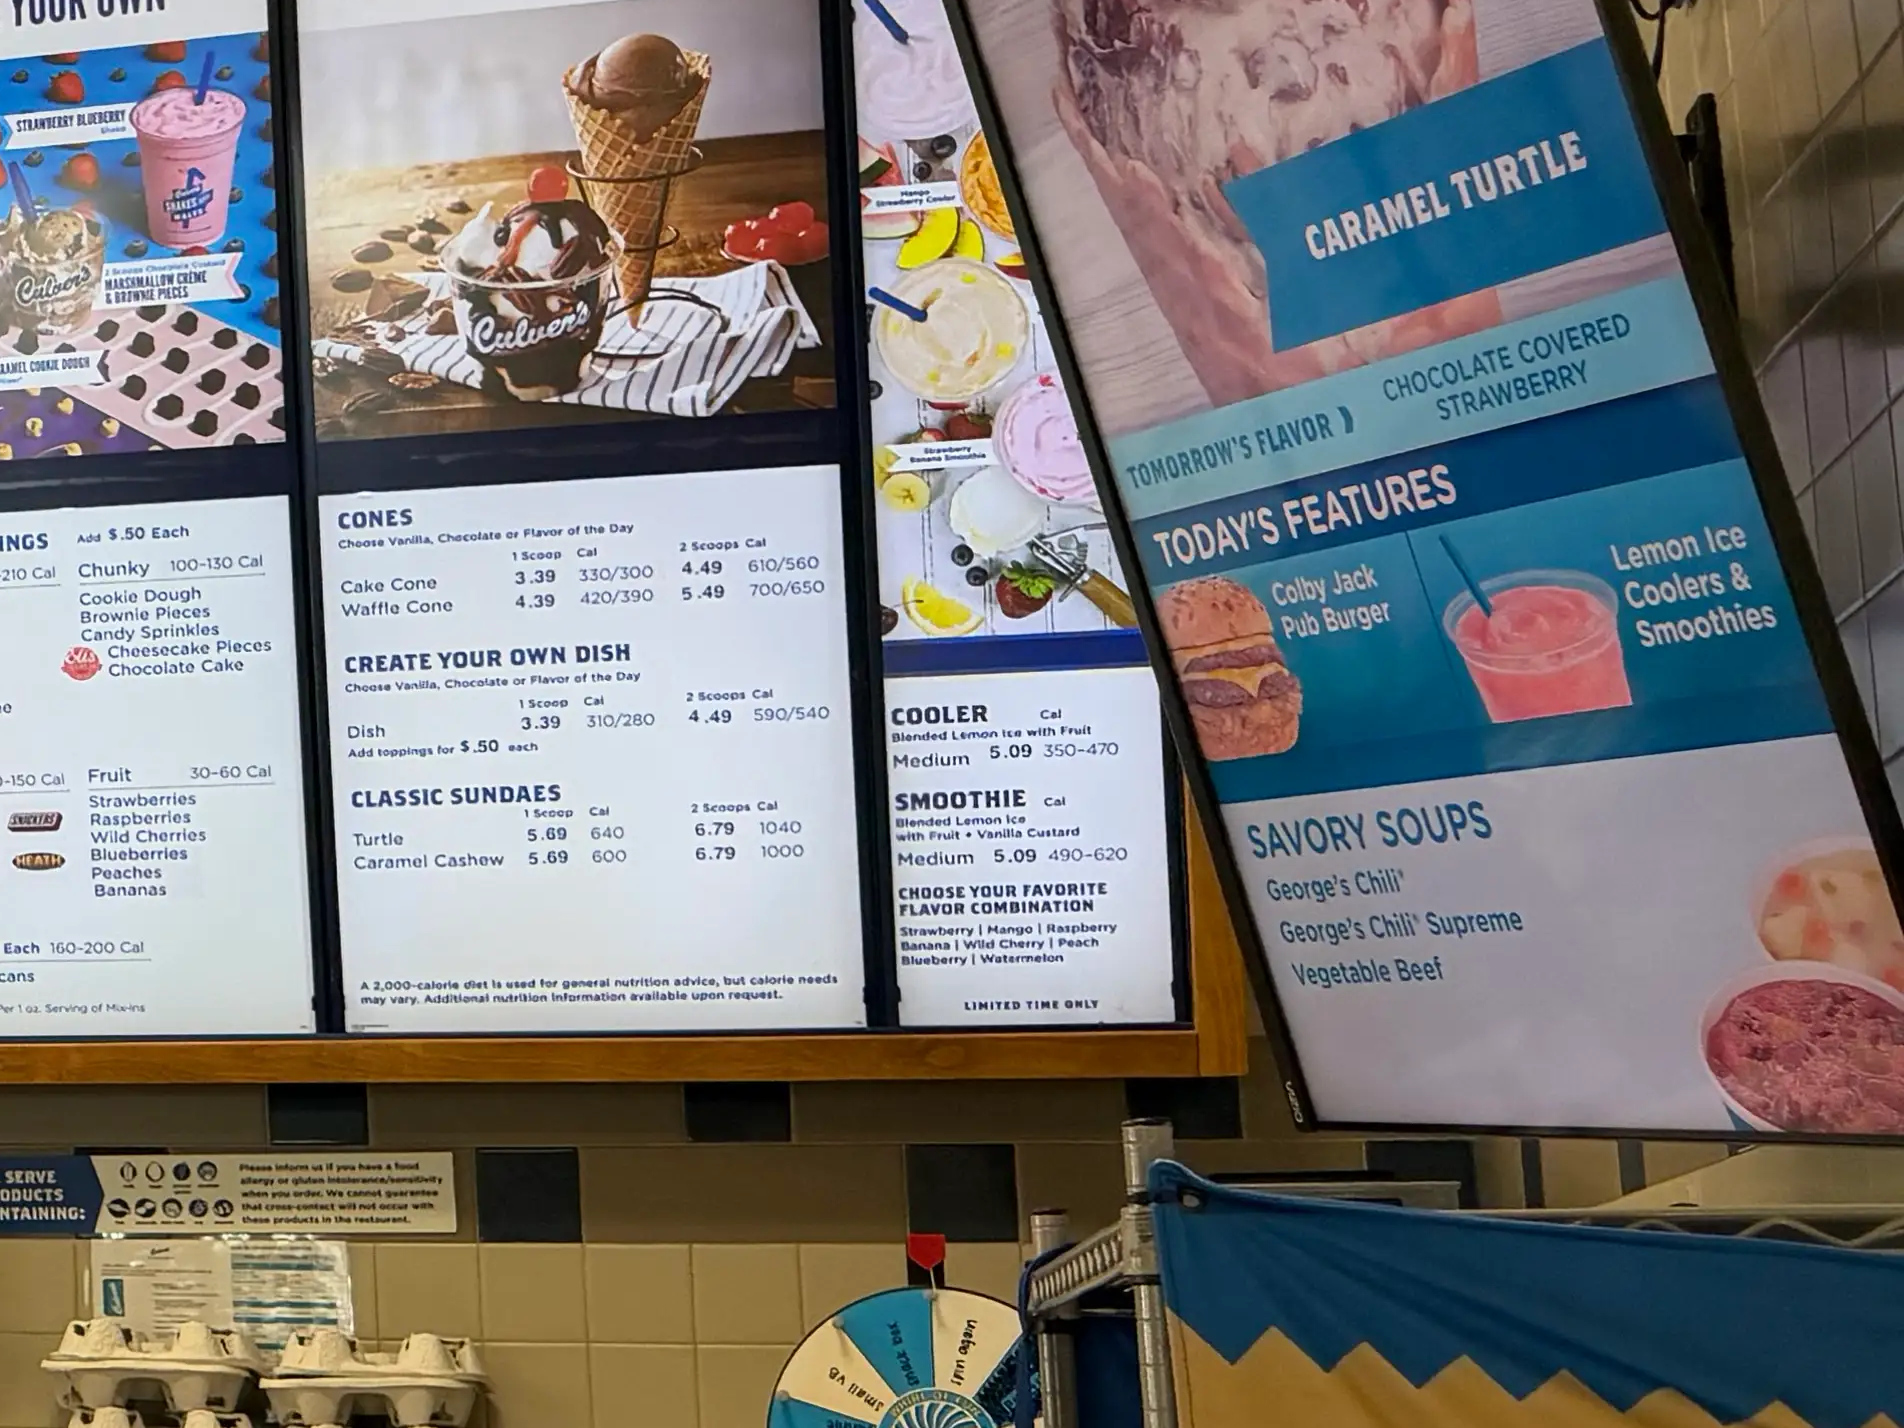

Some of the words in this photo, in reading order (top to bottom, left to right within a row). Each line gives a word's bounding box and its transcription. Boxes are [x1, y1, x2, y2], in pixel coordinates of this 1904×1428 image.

[1305, 182, 1449, 259] CARAMEL
[1450, 132, 1587, 208] TURTLE
[1382, 342, 1514, 403] CHOCOLATE
[1517, 314, 1631, 365] COVERED
[1436, 358, 1590, 422] STRAWBERRY
[1126, 435, 1252, 488] TOMORROW'S
[1255, 414, 1333, 455] FLAVOR
[338, 509, 412, 529] CONES
[1153, 507, 1279, 567] TODAY'S
[1283, 464, 1457, 538] FEATURES
[1610, 536, 1700, 570] Lemon
[1704, 526, 1746, 552] Ice
[1272, 577, 1325, 605] Colby
[1333, 564, 1377, 594] Jack
[1625, 573, 1725, 608] Coolers
[1730, 562, 1751, 590] &
[341, 602, 397, 616] Waffle
[407, 600, 453, 613] Cone
[1281, 612, 1319, 639] Pub
[1322, 603, 1389, 631] Burger
[1636, 603, 1777, 647] Smoothies
[891, 705, 987, 725] COOLER
[89, 792, 196, 808] Strawberries
[352, 789, 443, 808] CLASSIC
[451, 785, 561, 804] SUNDAES
[895, 790, 1026, 811] SMOOTHIE
[1247, 814, 1365, 859] SAVORY
[1376, 801, 1492, 847] SOUPS
[1267, 875, 1351, 903] George's
[1280, 918, 1365, 945] George's
[1425, 912, 1523, 938] Supreme
[1292, 960, 1391, 988] Vegetable
[1394, 956, 1443, 981] Beef
[6, 1171, 56, 1183] SERVE
